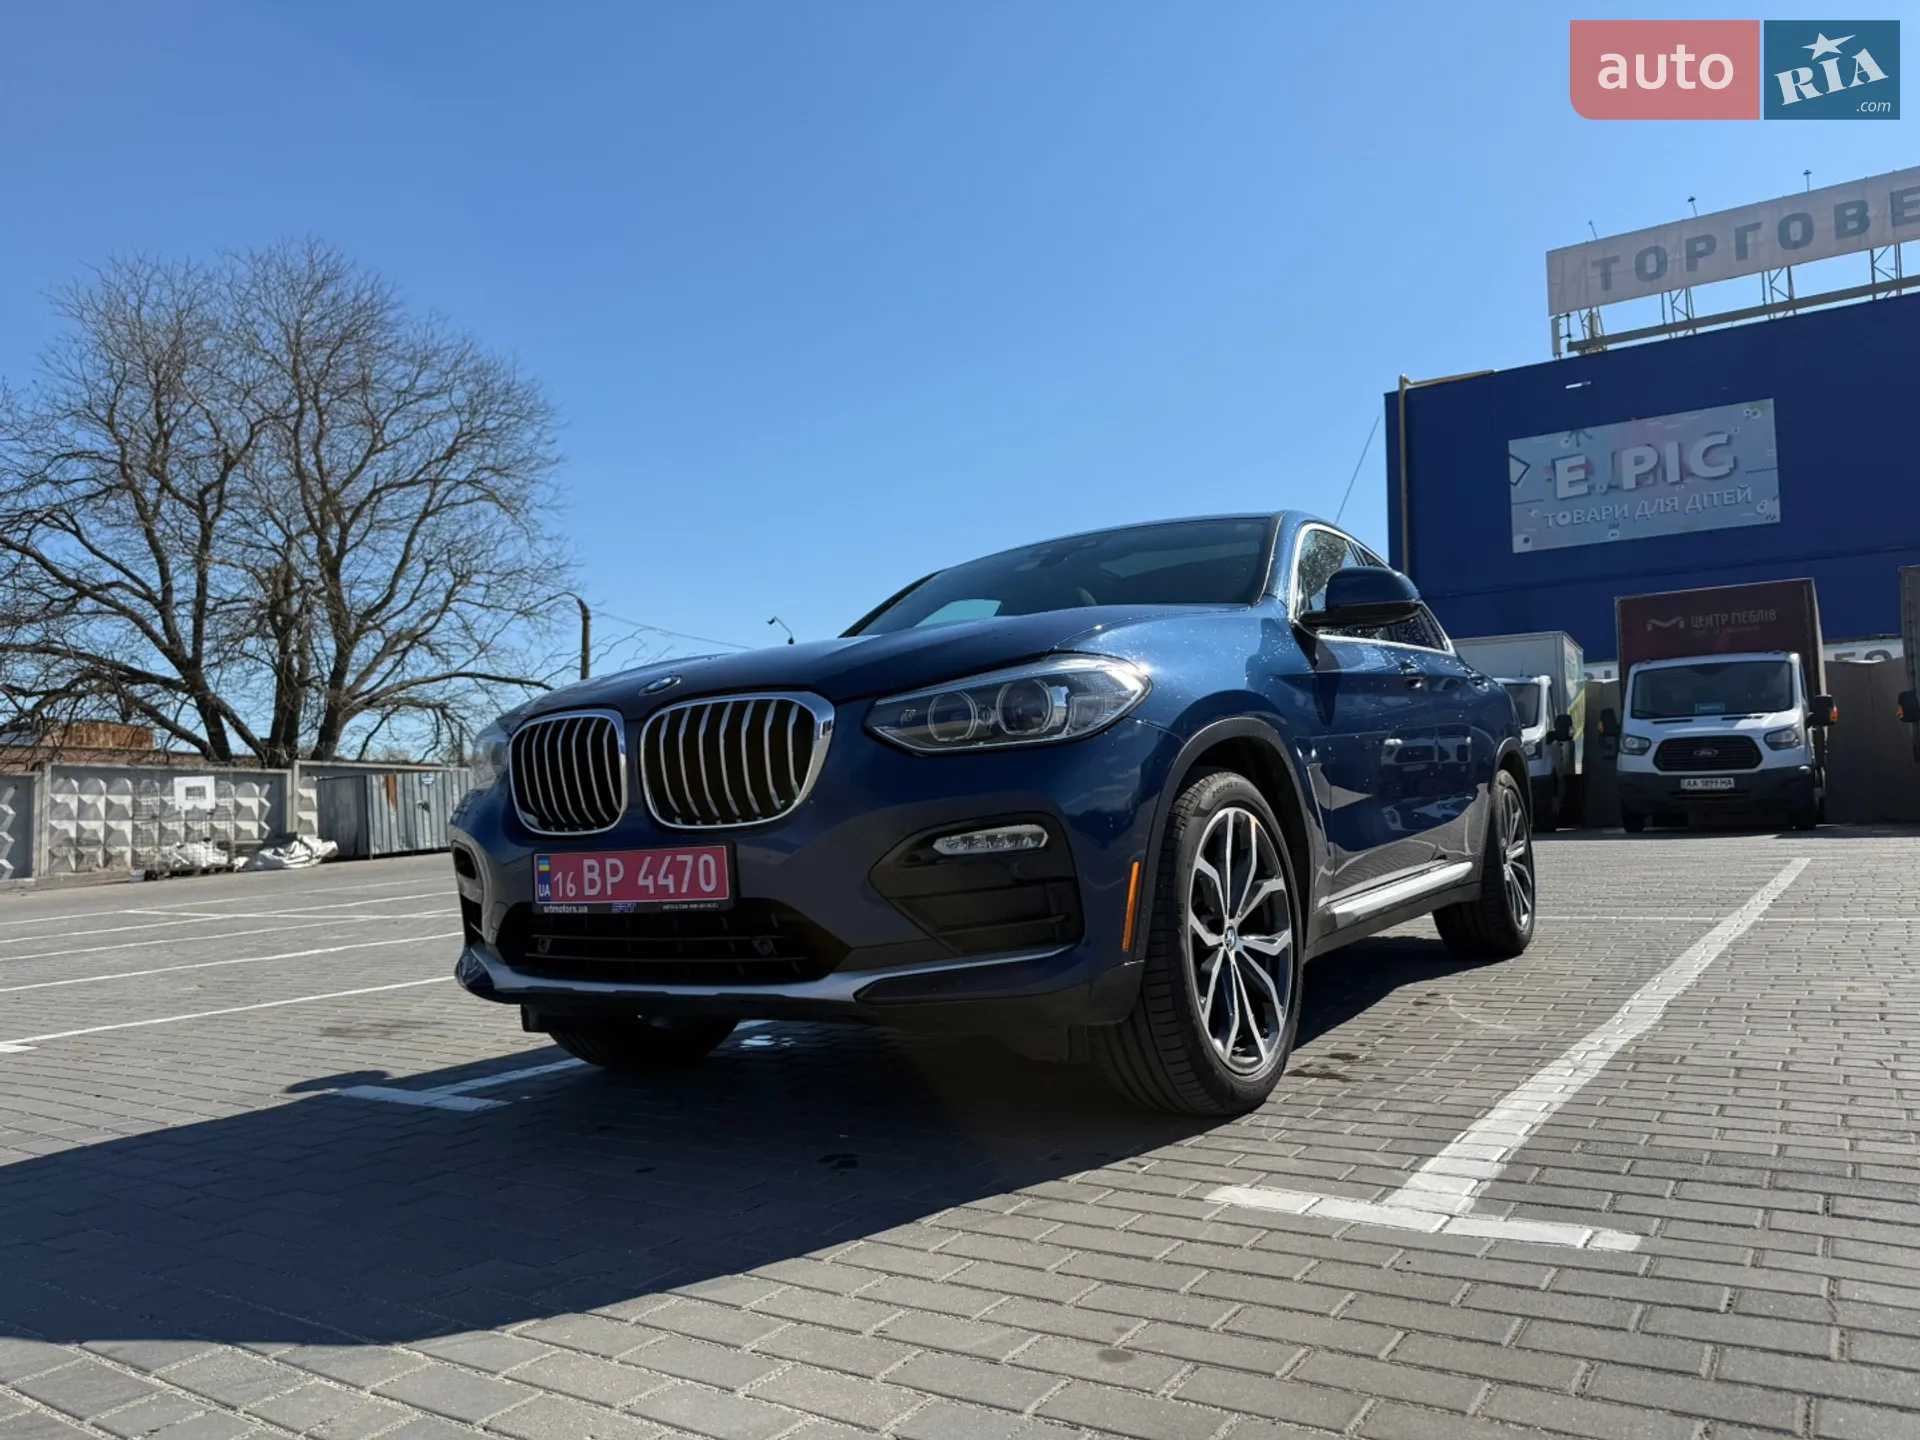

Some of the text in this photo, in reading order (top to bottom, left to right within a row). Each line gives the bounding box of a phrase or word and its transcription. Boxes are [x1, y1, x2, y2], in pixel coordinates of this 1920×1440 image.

[1543, 484, 1752, 528] ТОВАРИ ДЛЯ ДІТЕЙ
[1691, 608, 1777, 628] ЦЕНТР МЕБЛІВ
[538, 883, 551, 897] UA
[553, 853, 717, 897] 16 BP 4470
